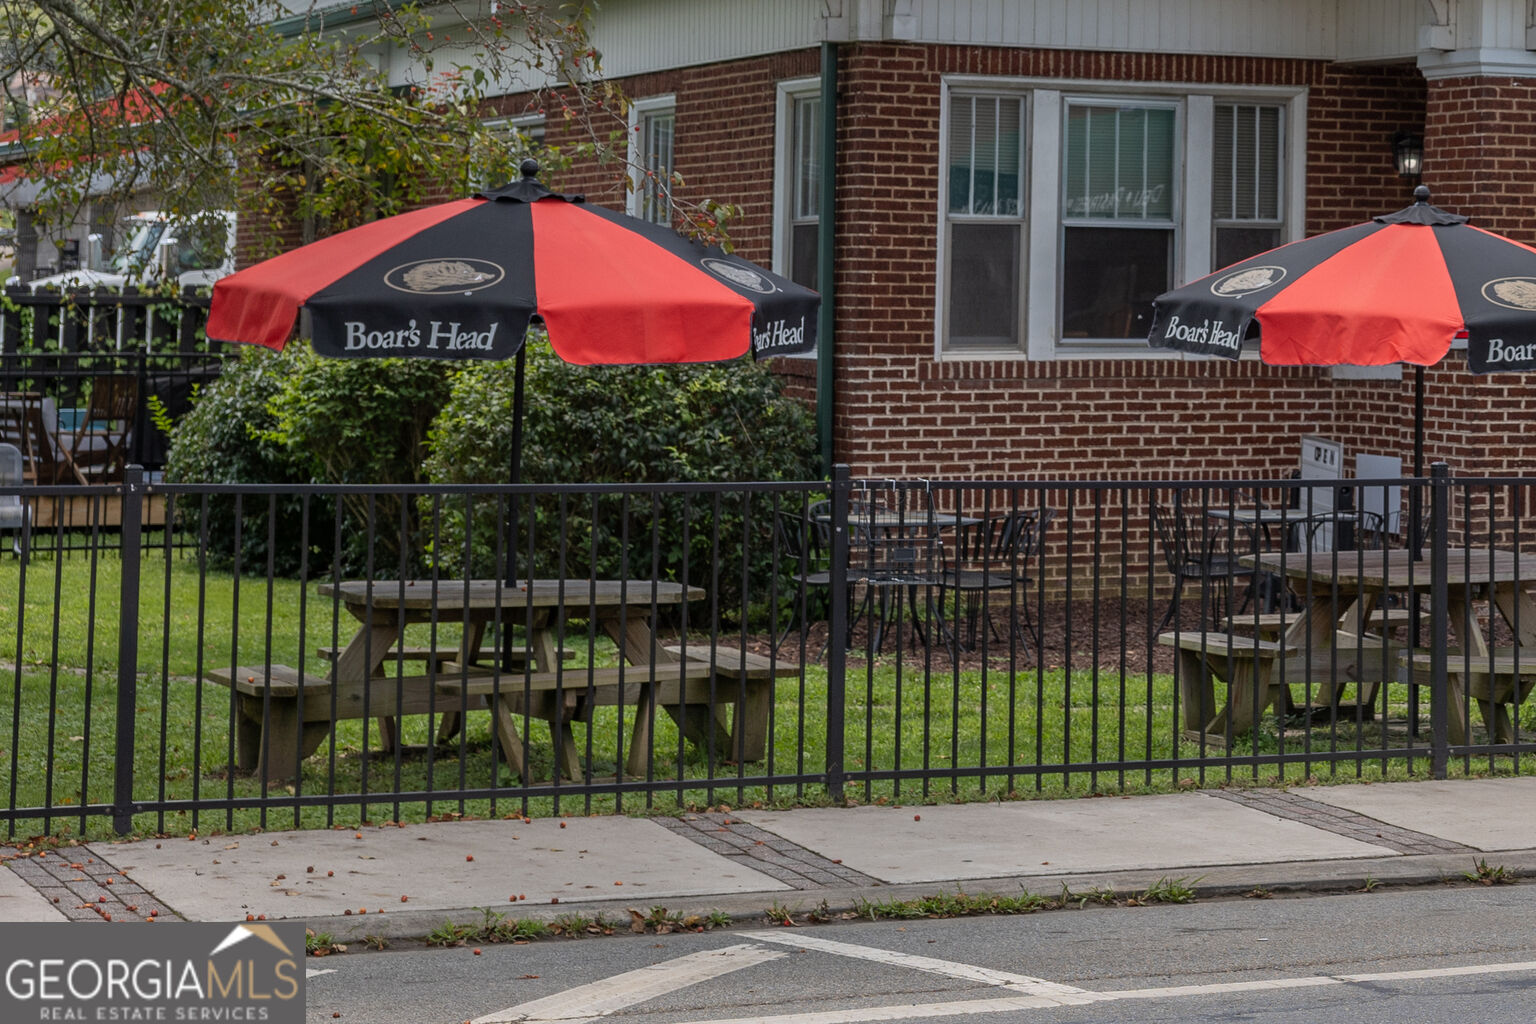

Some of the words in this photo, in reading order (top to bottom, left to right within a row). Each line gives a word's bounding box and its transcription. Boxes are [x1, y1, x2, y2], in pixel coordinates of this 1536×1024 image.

[344, 318, 421, 351] Boar's
[427, 320, 499, 351] Head
[771, 316, 805, 347] Head
[1164, 315, 1209, 344] Boar's
[1208, 320, 1241, 350] Head
